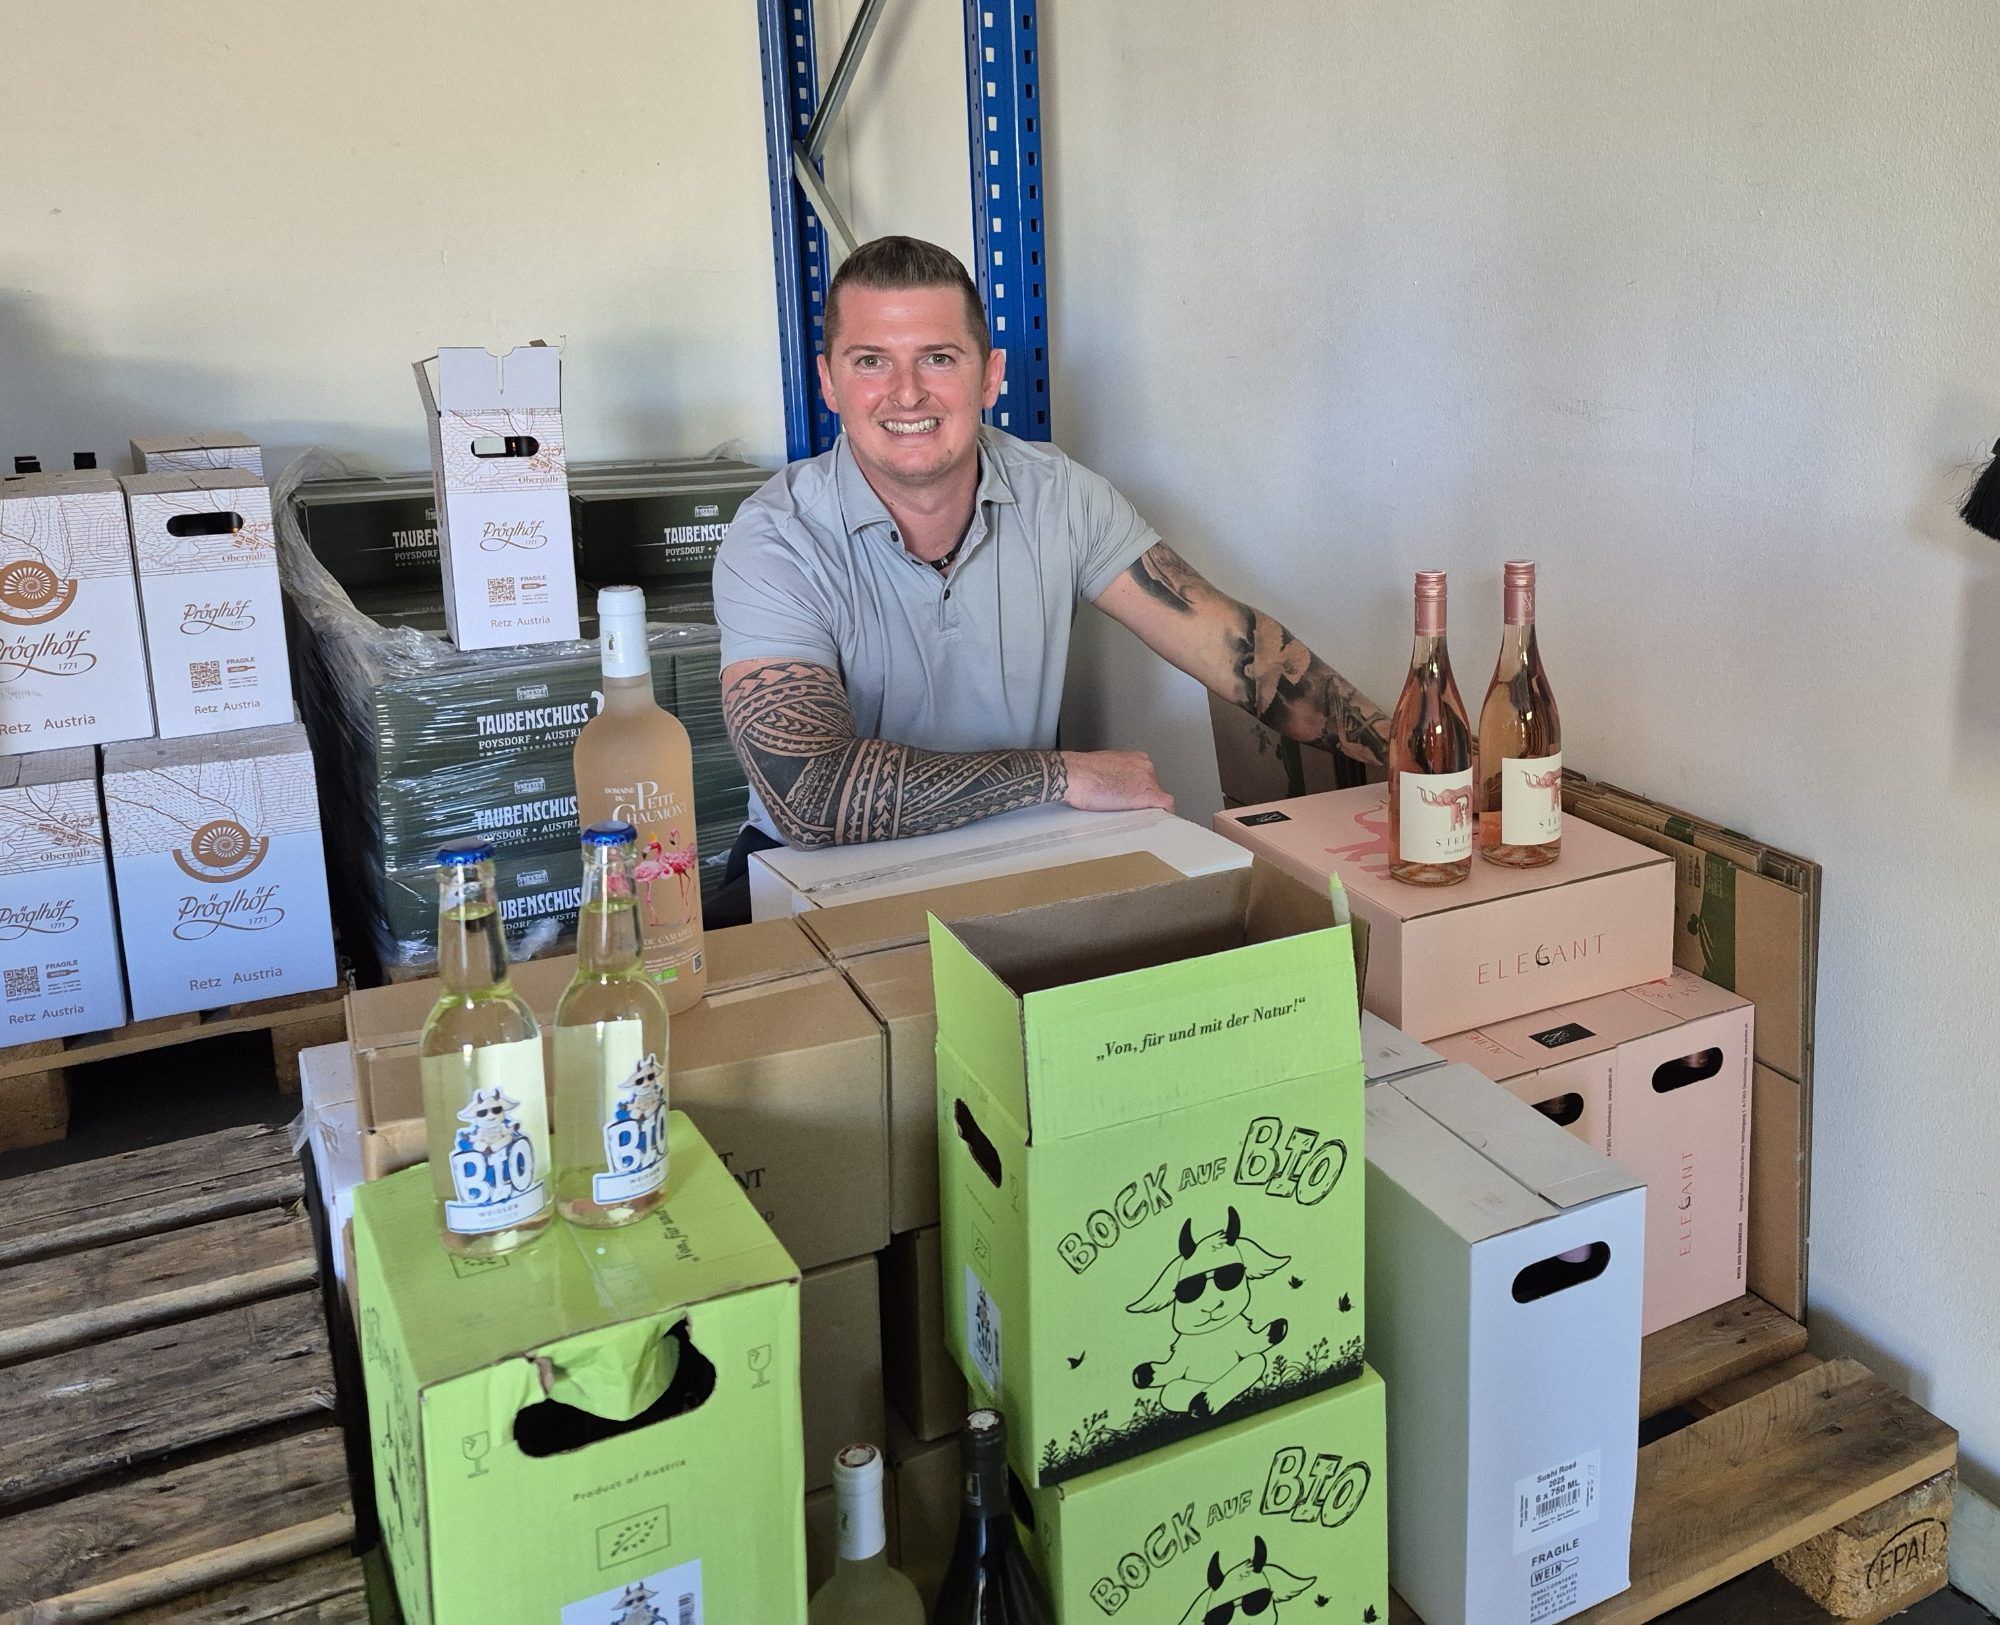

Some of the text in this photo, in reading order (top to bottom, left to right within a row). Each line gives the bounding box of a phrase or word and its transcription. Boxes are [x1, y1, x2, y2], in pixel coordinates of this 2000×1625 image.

[480, 520, 548, 551] Pröglhöf
[663, 523, 730, 544] TAUBENSCH
[394, 550, 439, 561] POYSDORF
[665, 545, 705, 557] POYSDORF
[180, 600, 255, 635] Pröglhöf
[490, 615, 551, 629] Retz Austria
[58, 661, 78, 672] 1771
[194, 699, 261, 715] Retz Austria
[476, 702, 590, 736] TAUBENSCHUSS
[43, 713, 97, 731] Austria
[478, 727, 582, 750] POYSDORF AUSTRI
[472, 795, 579, 831] TAUBENSCHUS
[541, 818, 580, 833] AUSTRI
[173, 884, 285, 940] Pröglhöf
[249, 917, 267, 925] 1771
[45, 959, 79, 970] FRAGILE
[1478, 933, 1606, 985] ELEGANT
[189, 966, 284, 992] Retz Austria
[9, 1004, 85, 1025] Retz Austria
[1139, 1032, 1166, 1053] für
[1168, 1023, 1197, 1043] und
[1200, 1018, 1223, 1035] mit
[1226, 1013, 1250, 1029] der
[604, 1101, 667, 1174] BIO
[451, 1136, 535, 1206] BIO
[1057, 1163, 1174, 1275] BOCK
[1179, 1157, 1227, 1192] AUF
[1234, 1116, 1348, 1206] BIO
[1678, 1151, 1694, 1257] ELEGANT
[573, 1460, 686, 1502] Product of Austria
[1536, 1469, 1558, 1484] Sushi
[1548, 1475, 1565, 1488] 2025
[1535, 1494, 1541, 1504] 6
[1551, 1484, 1566, 1498] 750
[1567, 1479, 1580, 1490] ML
[1090, 1446, 1371, 1616] BOCK AUF BIO
[1531, 1538, 1579, 1567] FRAGILE
[1534, 1562, 1562, 1584] WEIN
